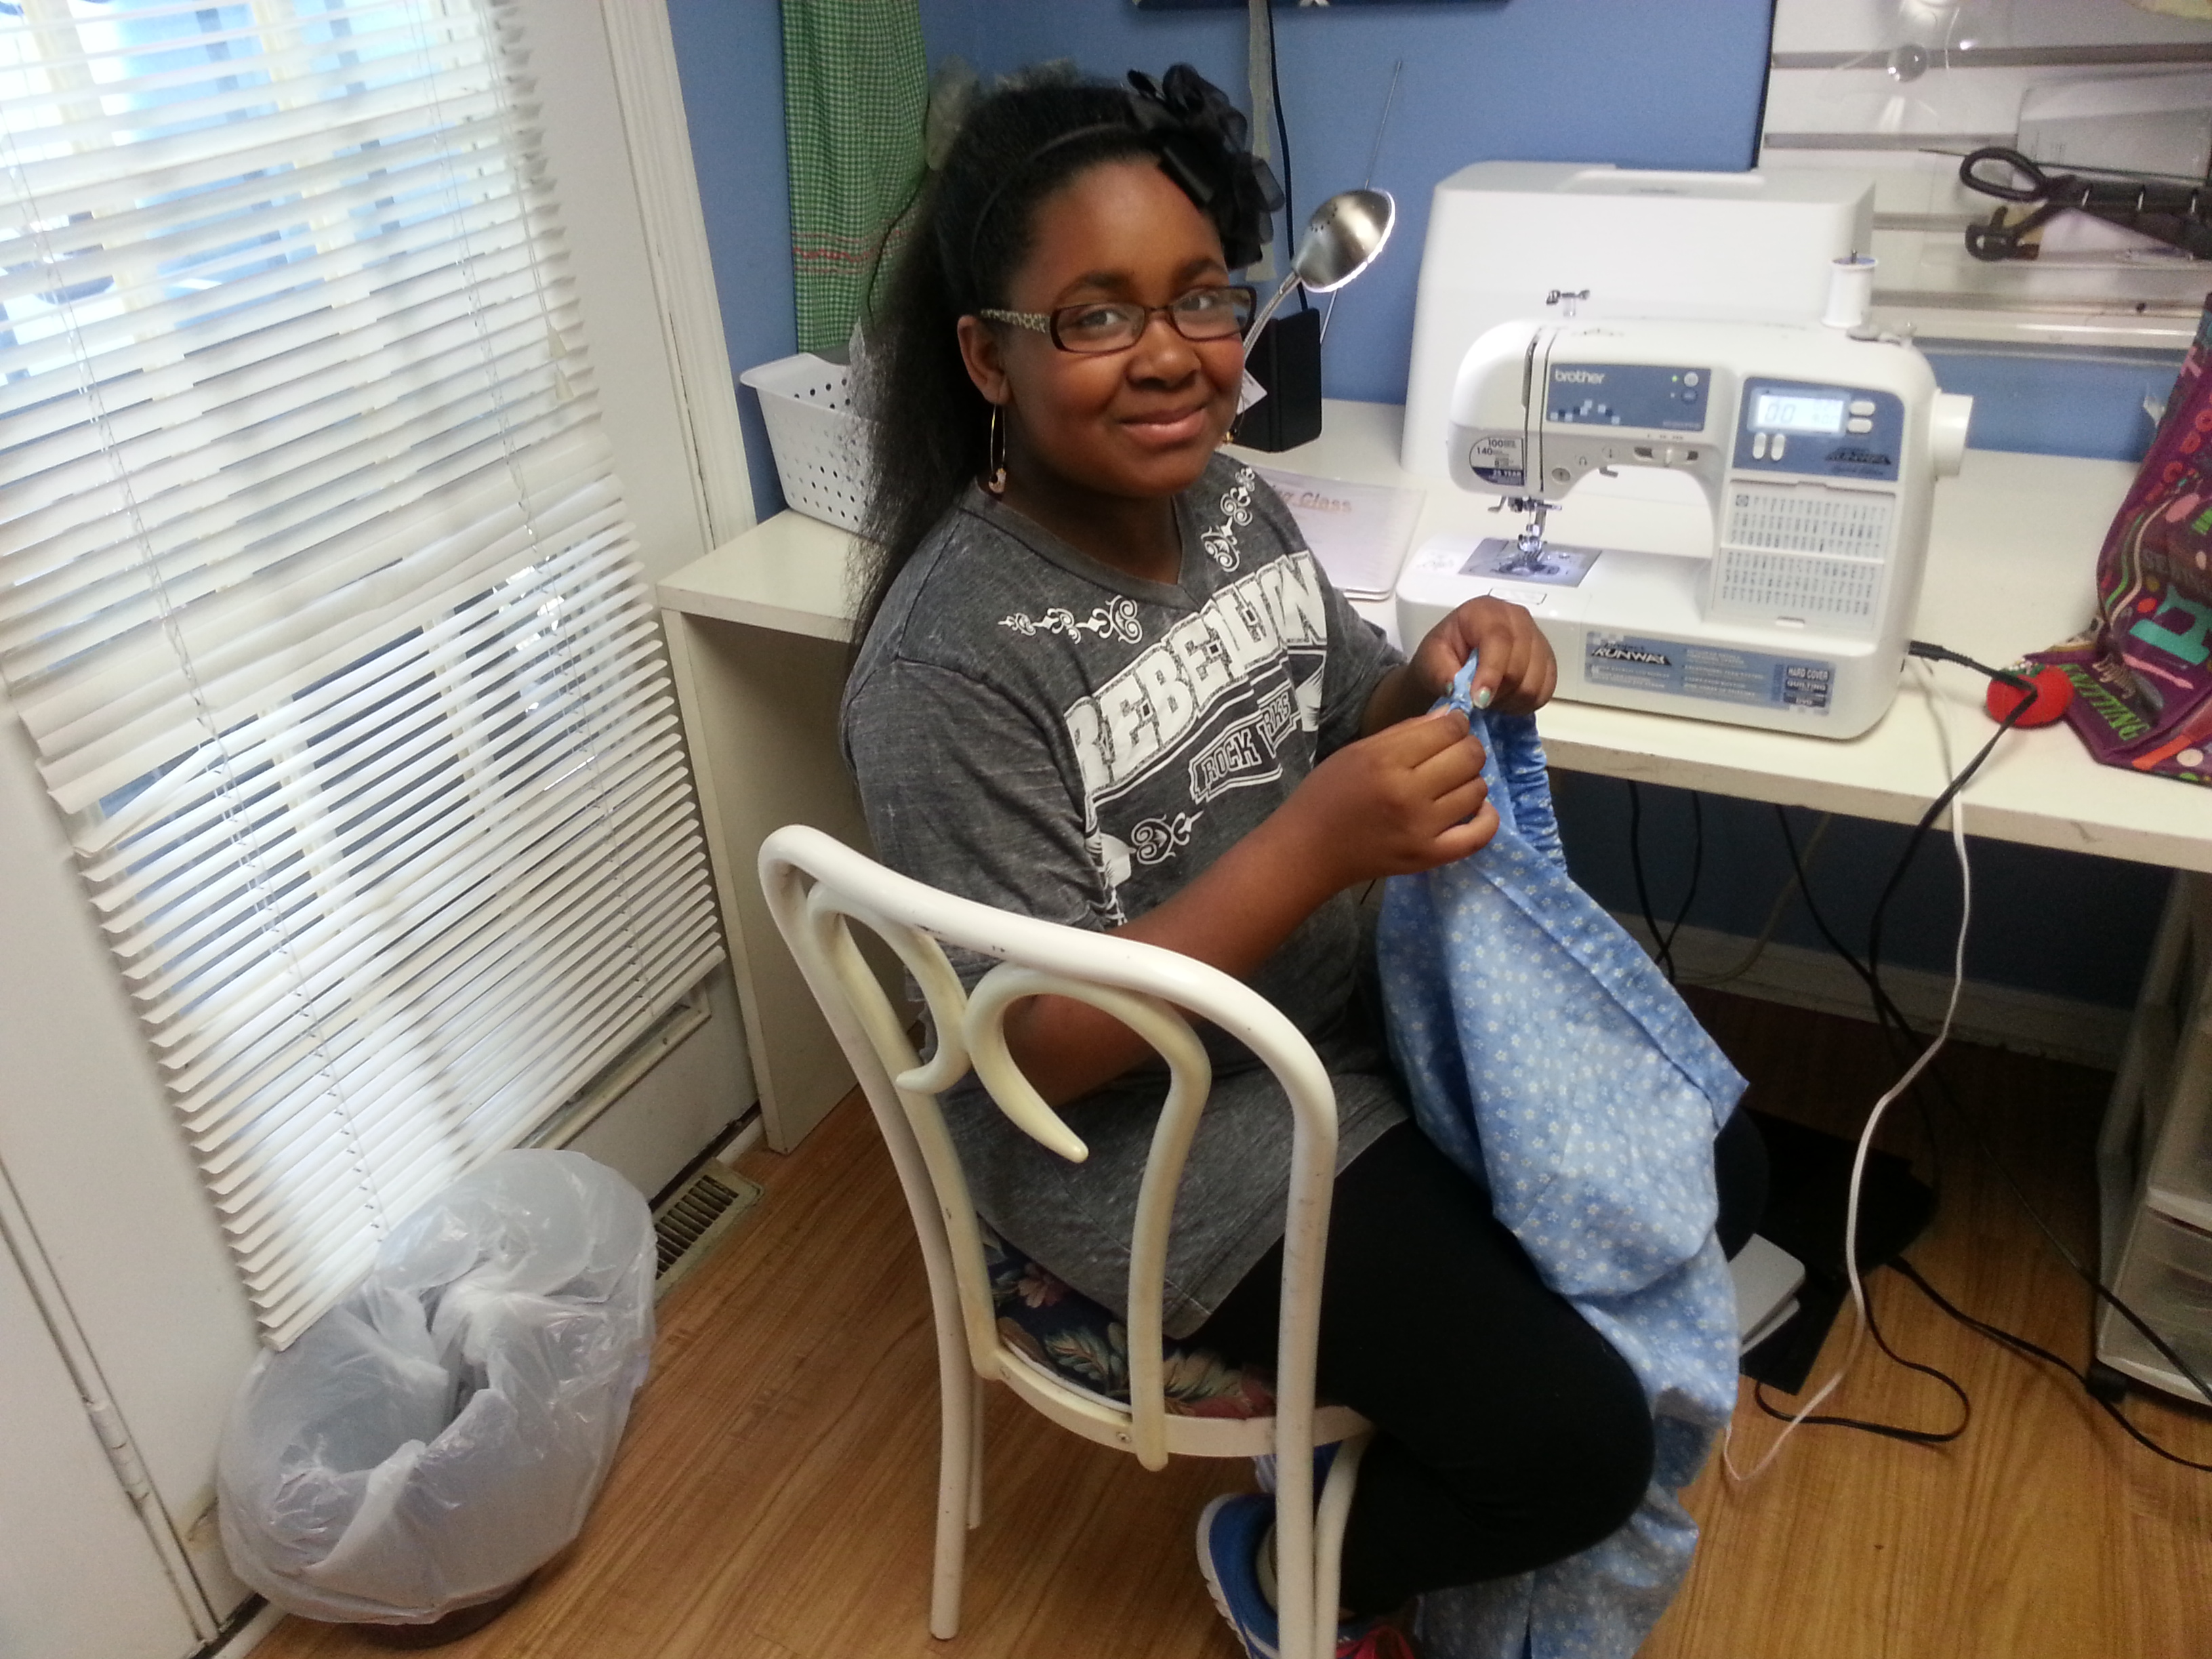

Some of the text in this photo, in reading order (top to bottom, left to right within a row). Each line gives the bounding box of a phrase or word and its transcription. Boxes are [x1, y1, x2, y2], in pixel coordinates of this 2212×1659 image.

[1555, 369, 1605, 384] brother
[1488, 437, 1504, 447] 100
[1477, 447, 1493, 455] 140
[1201, 727, 1263, 785] ROCK
